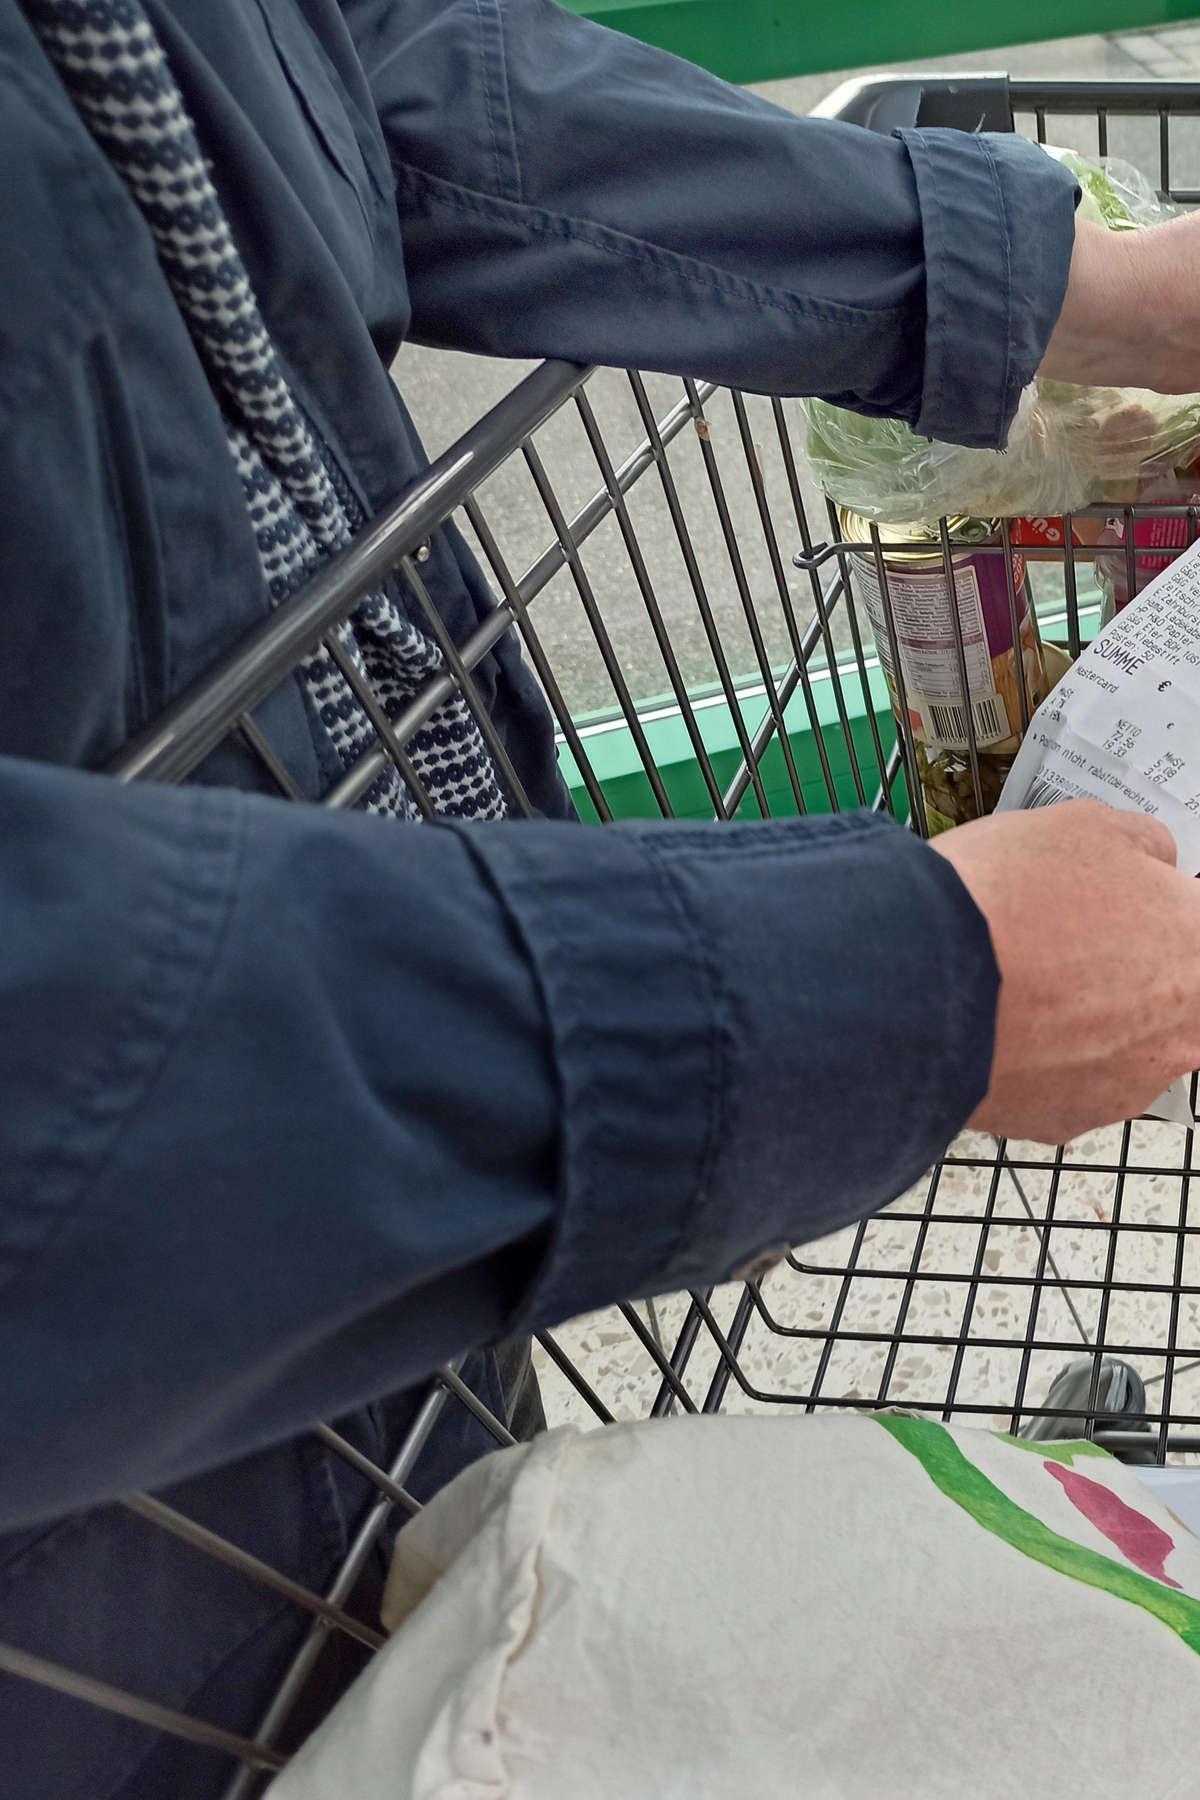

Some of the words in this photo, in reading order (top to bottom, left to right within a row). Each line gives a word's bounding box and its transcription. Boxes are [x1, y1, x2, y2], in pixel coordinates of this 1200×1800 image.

[1131, 631, 1180, 665] Klebestift
[1141, 623, 1163, 639] Eier
[1163, 624, 1195, 646] Papier
[1072, 667, 1120, 693] Mastercard
[1091, 639, 1146, 675] SUMME
[1154, 679, 1173, 692] €
[1101, 738, 1127, 759] 19,33
[1143, 766, 1167, 786] 3,67
[1112, 730, 1136, 750] 72,56
[1153, 758, 1178, 779] 5,08
[1162, 750, 1185, 771] MwSt
[1061, 747, 1086, 768] nicht
[1087, 763, 1158, 817] rabattberechtigt
